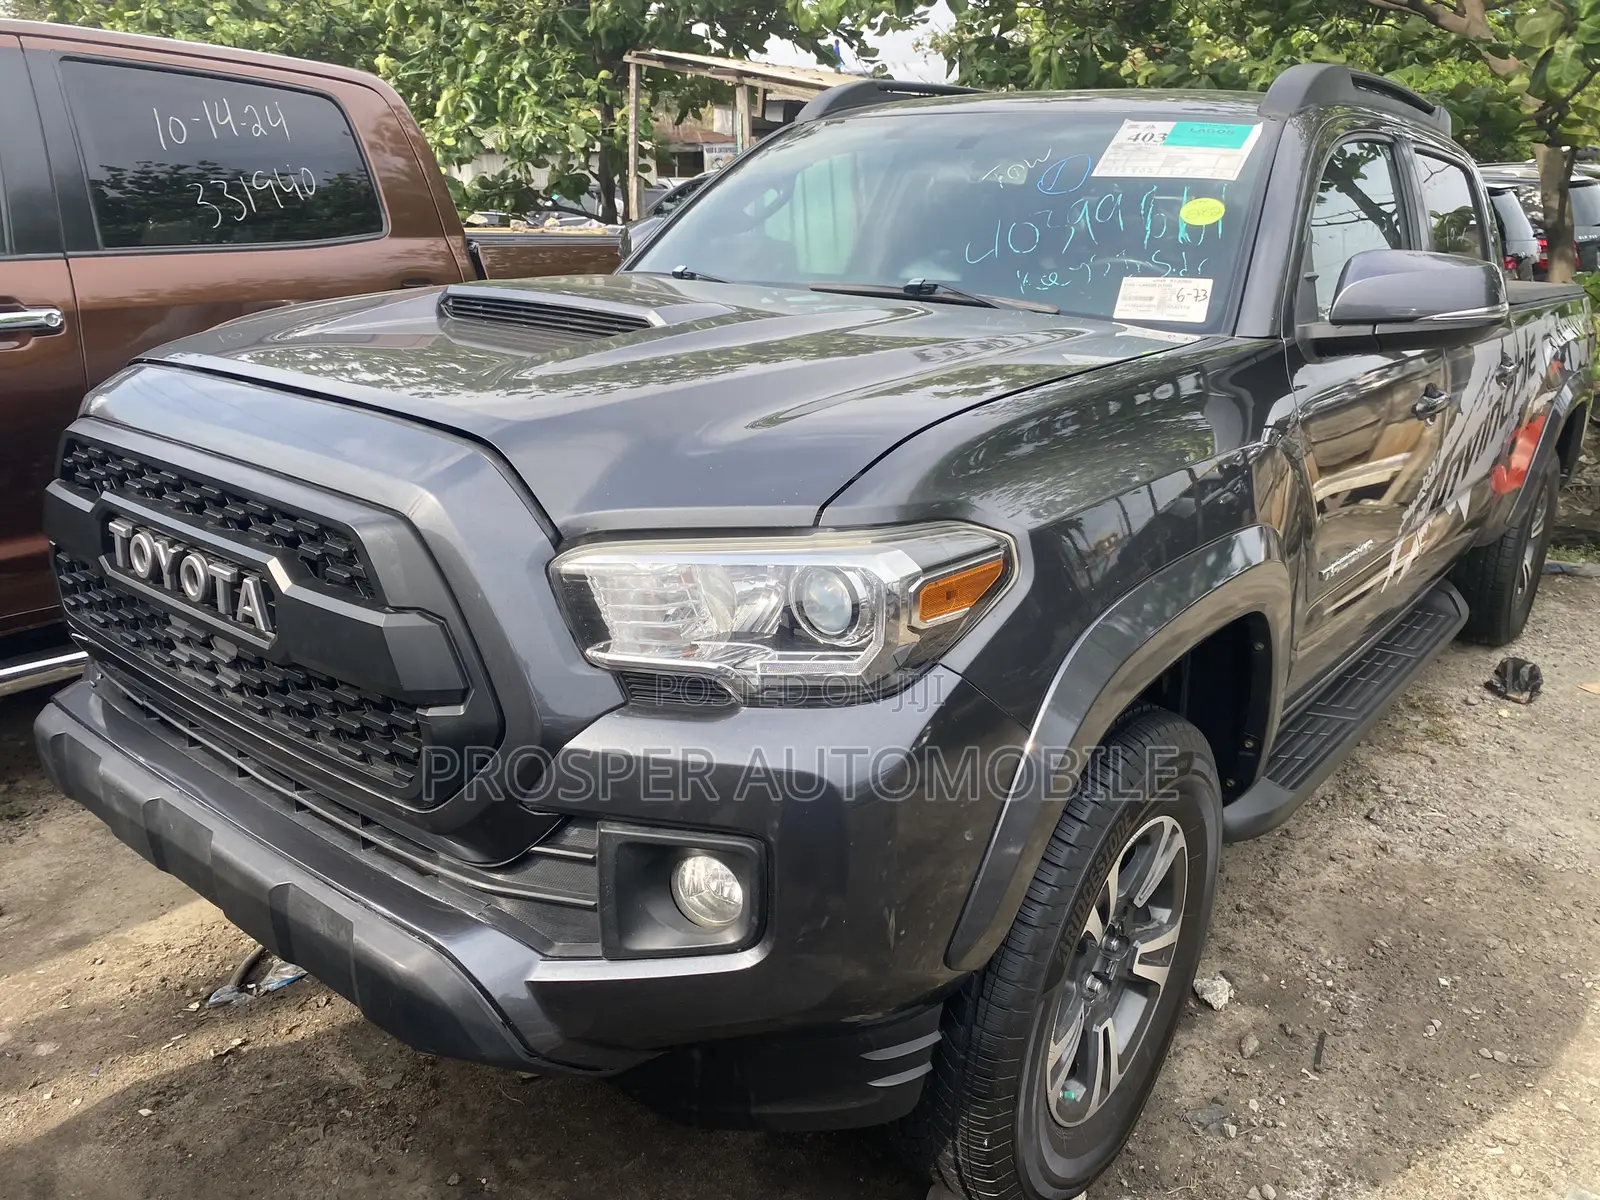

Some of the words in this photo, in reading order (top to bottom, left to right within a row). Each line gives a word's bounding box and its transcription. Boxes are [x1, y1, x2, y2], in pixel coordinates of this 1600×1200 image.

[152, 98, 292, 151] 10-14-24
[1127, 131, 1168, 143] 403
[1176, 287, 1209, 303] 6-73
[108, 517, 273, 633] TOYOTA
